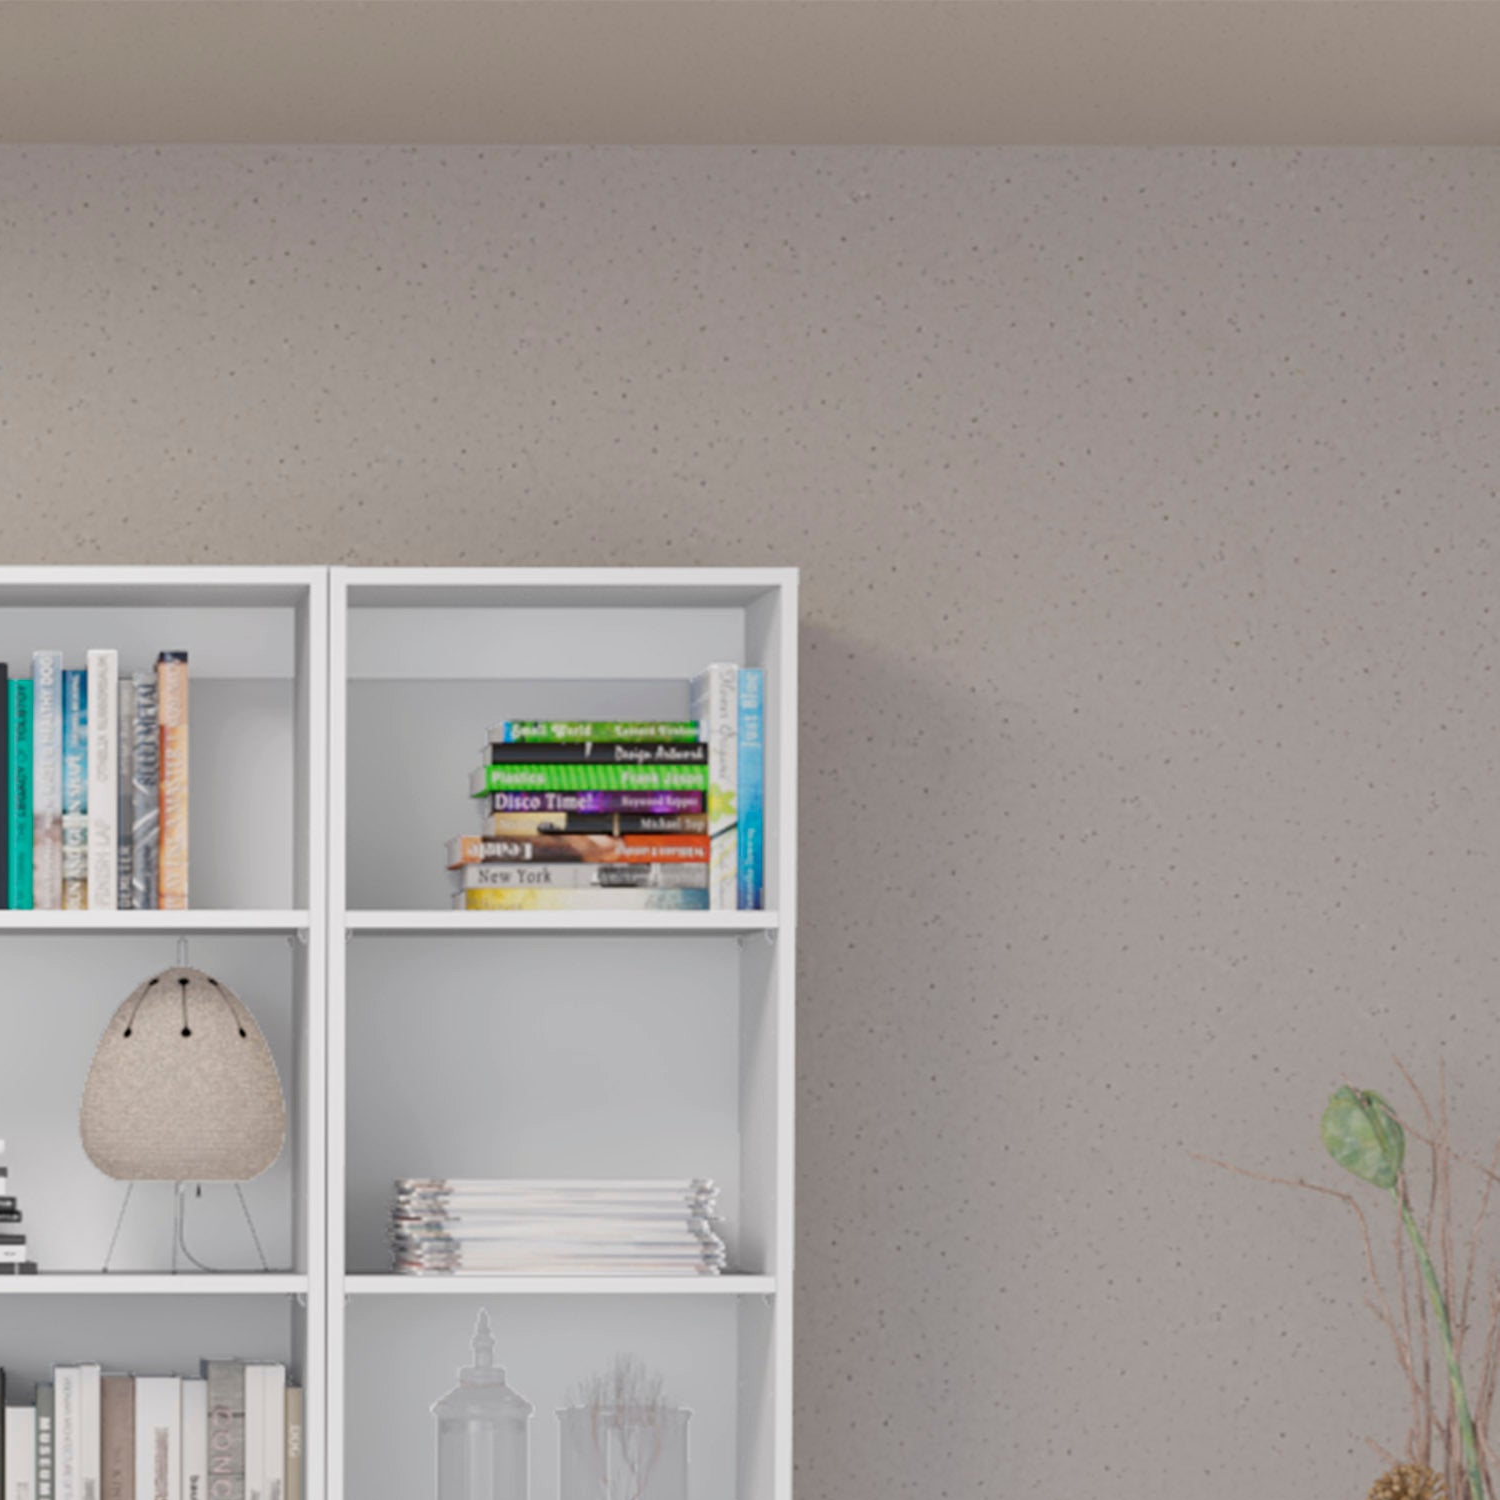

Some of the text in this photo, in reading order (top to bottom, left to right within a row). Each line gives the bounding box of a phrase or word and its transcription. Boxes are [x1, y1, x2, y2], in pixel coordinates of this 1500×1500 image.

[39, 656, 53, 685] DOG
[491, 771, 546, 785] Plastics
[494, 793, 596, 811] Disco Time!
[478, 868, 552, 884] New York
